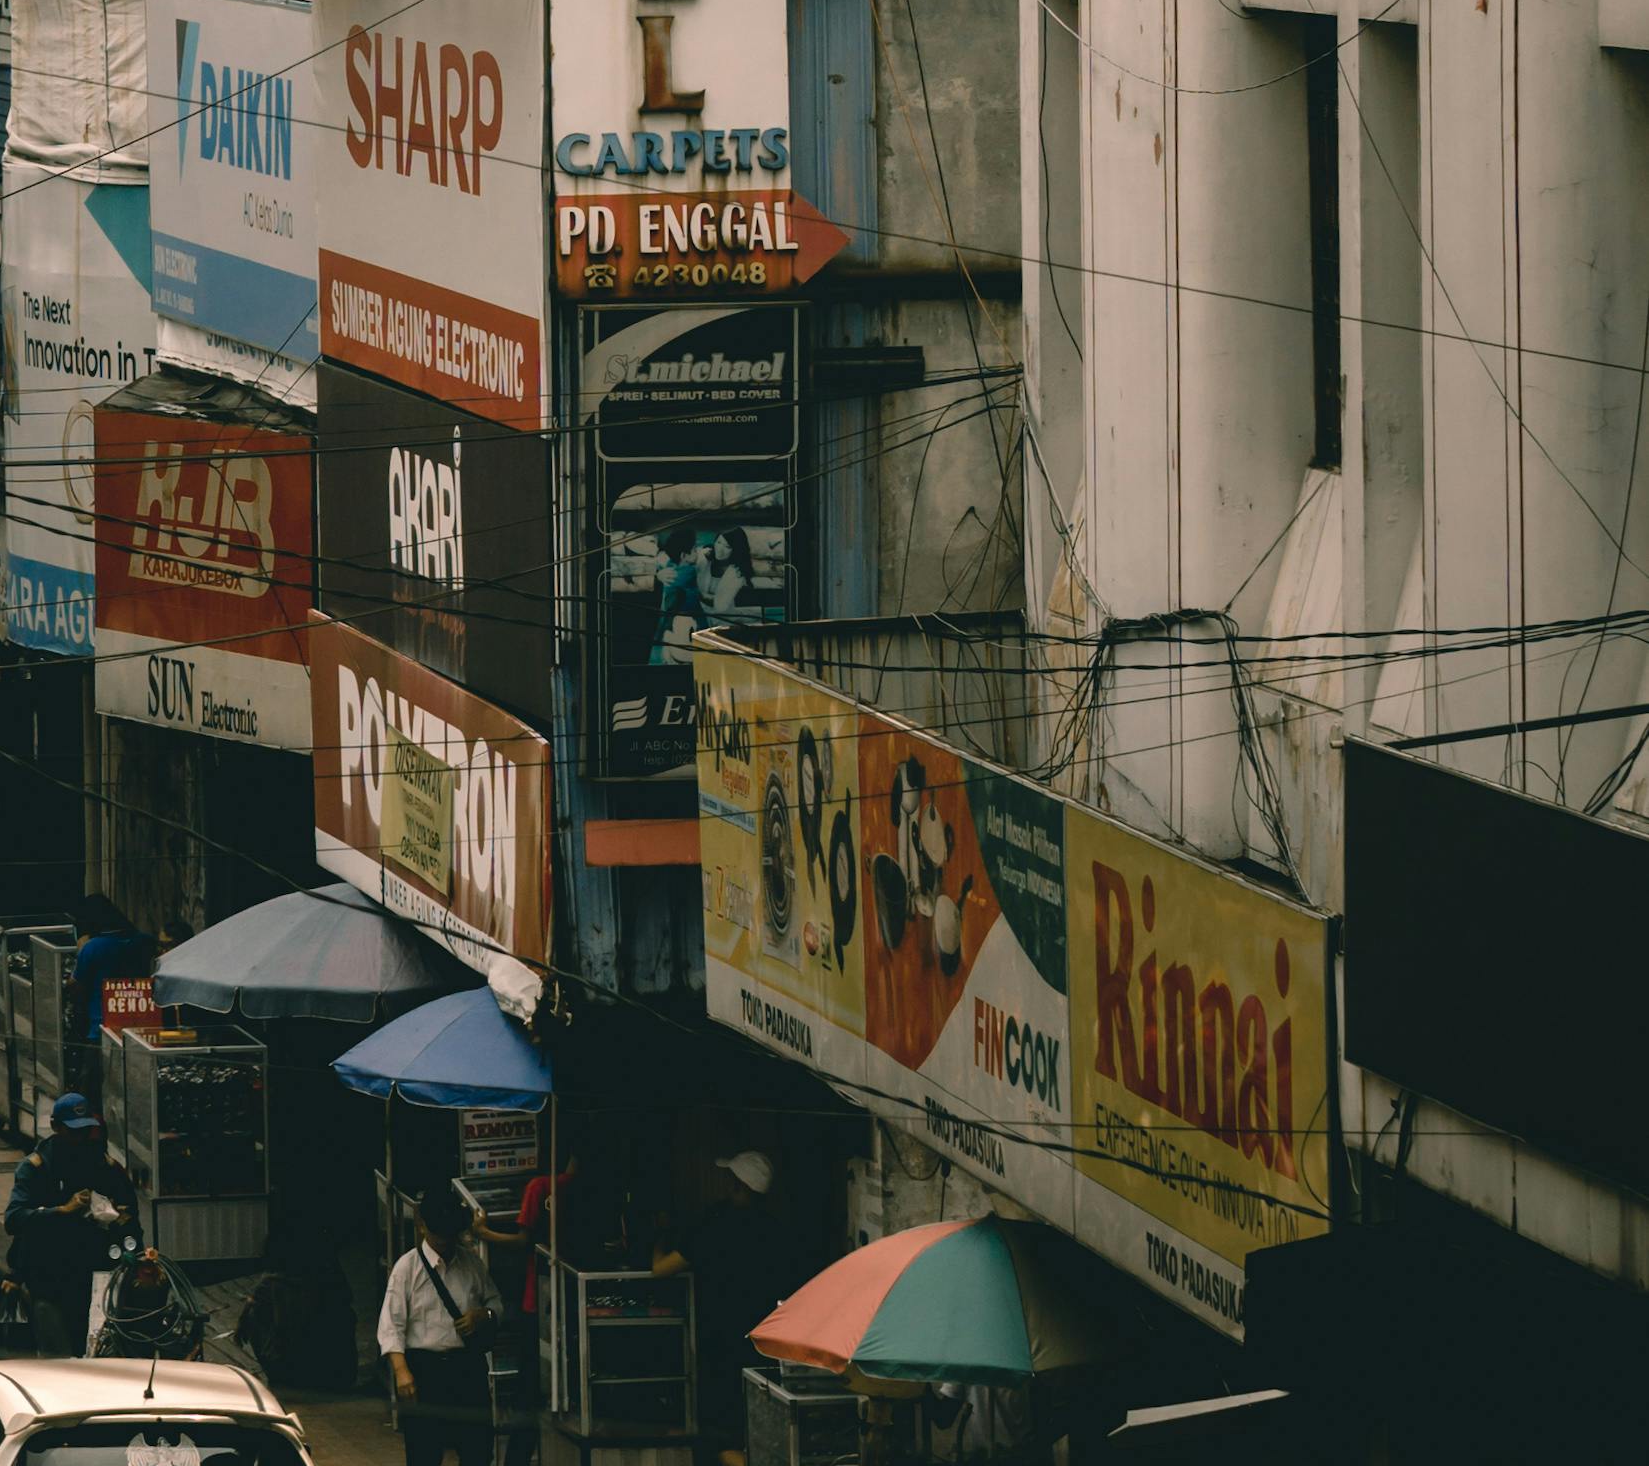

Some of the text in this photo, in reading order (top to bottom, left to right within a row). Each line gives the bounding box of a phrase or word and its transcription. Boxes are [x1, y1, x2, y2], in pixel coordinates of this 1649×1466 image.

[200, 61, 292, 181] DAIKIN
[346, 24, 504, 197] SHARP
[555, 127, 789, 180] CARPETS
[640, 201, 799, 256] ENGGAL
[23, 290, 71, 326] The Next
[633, 261, 767, 291] 4230048
[23, 335, 113, 380] Innovation
[117, 340, 137, 381] in
[331, 278, 385, 353] SUMBER
[387, 296, 434, 369] AGUNG
[436, 316, 525, 403] ELECTRONIC
[604, 350, 785, 386] St.michael
[607, 387, 782, 402] SPREI SELIMUT BED COVER
[143, 554, 244, 593] KARAJUKEBOX
[148, 654, 259, 739] SUN Electronic
[741, 988, 813, 1059] TOKO PADASUKA
[974, 995, 1062, 1113] FINCOOK
[1092, 859, 1299, 1183] Rinnai
[925, 1095, 950, 1133] TOKO
[952, 1114, 1005, 1180] PADASUKA
[1095, 1102, 1177, 1192] EXPERIENCE
[1180, 1148, 1209, 1209] OUR
[1146, 1229, 1245, 1328] TOKO PADASUKA
